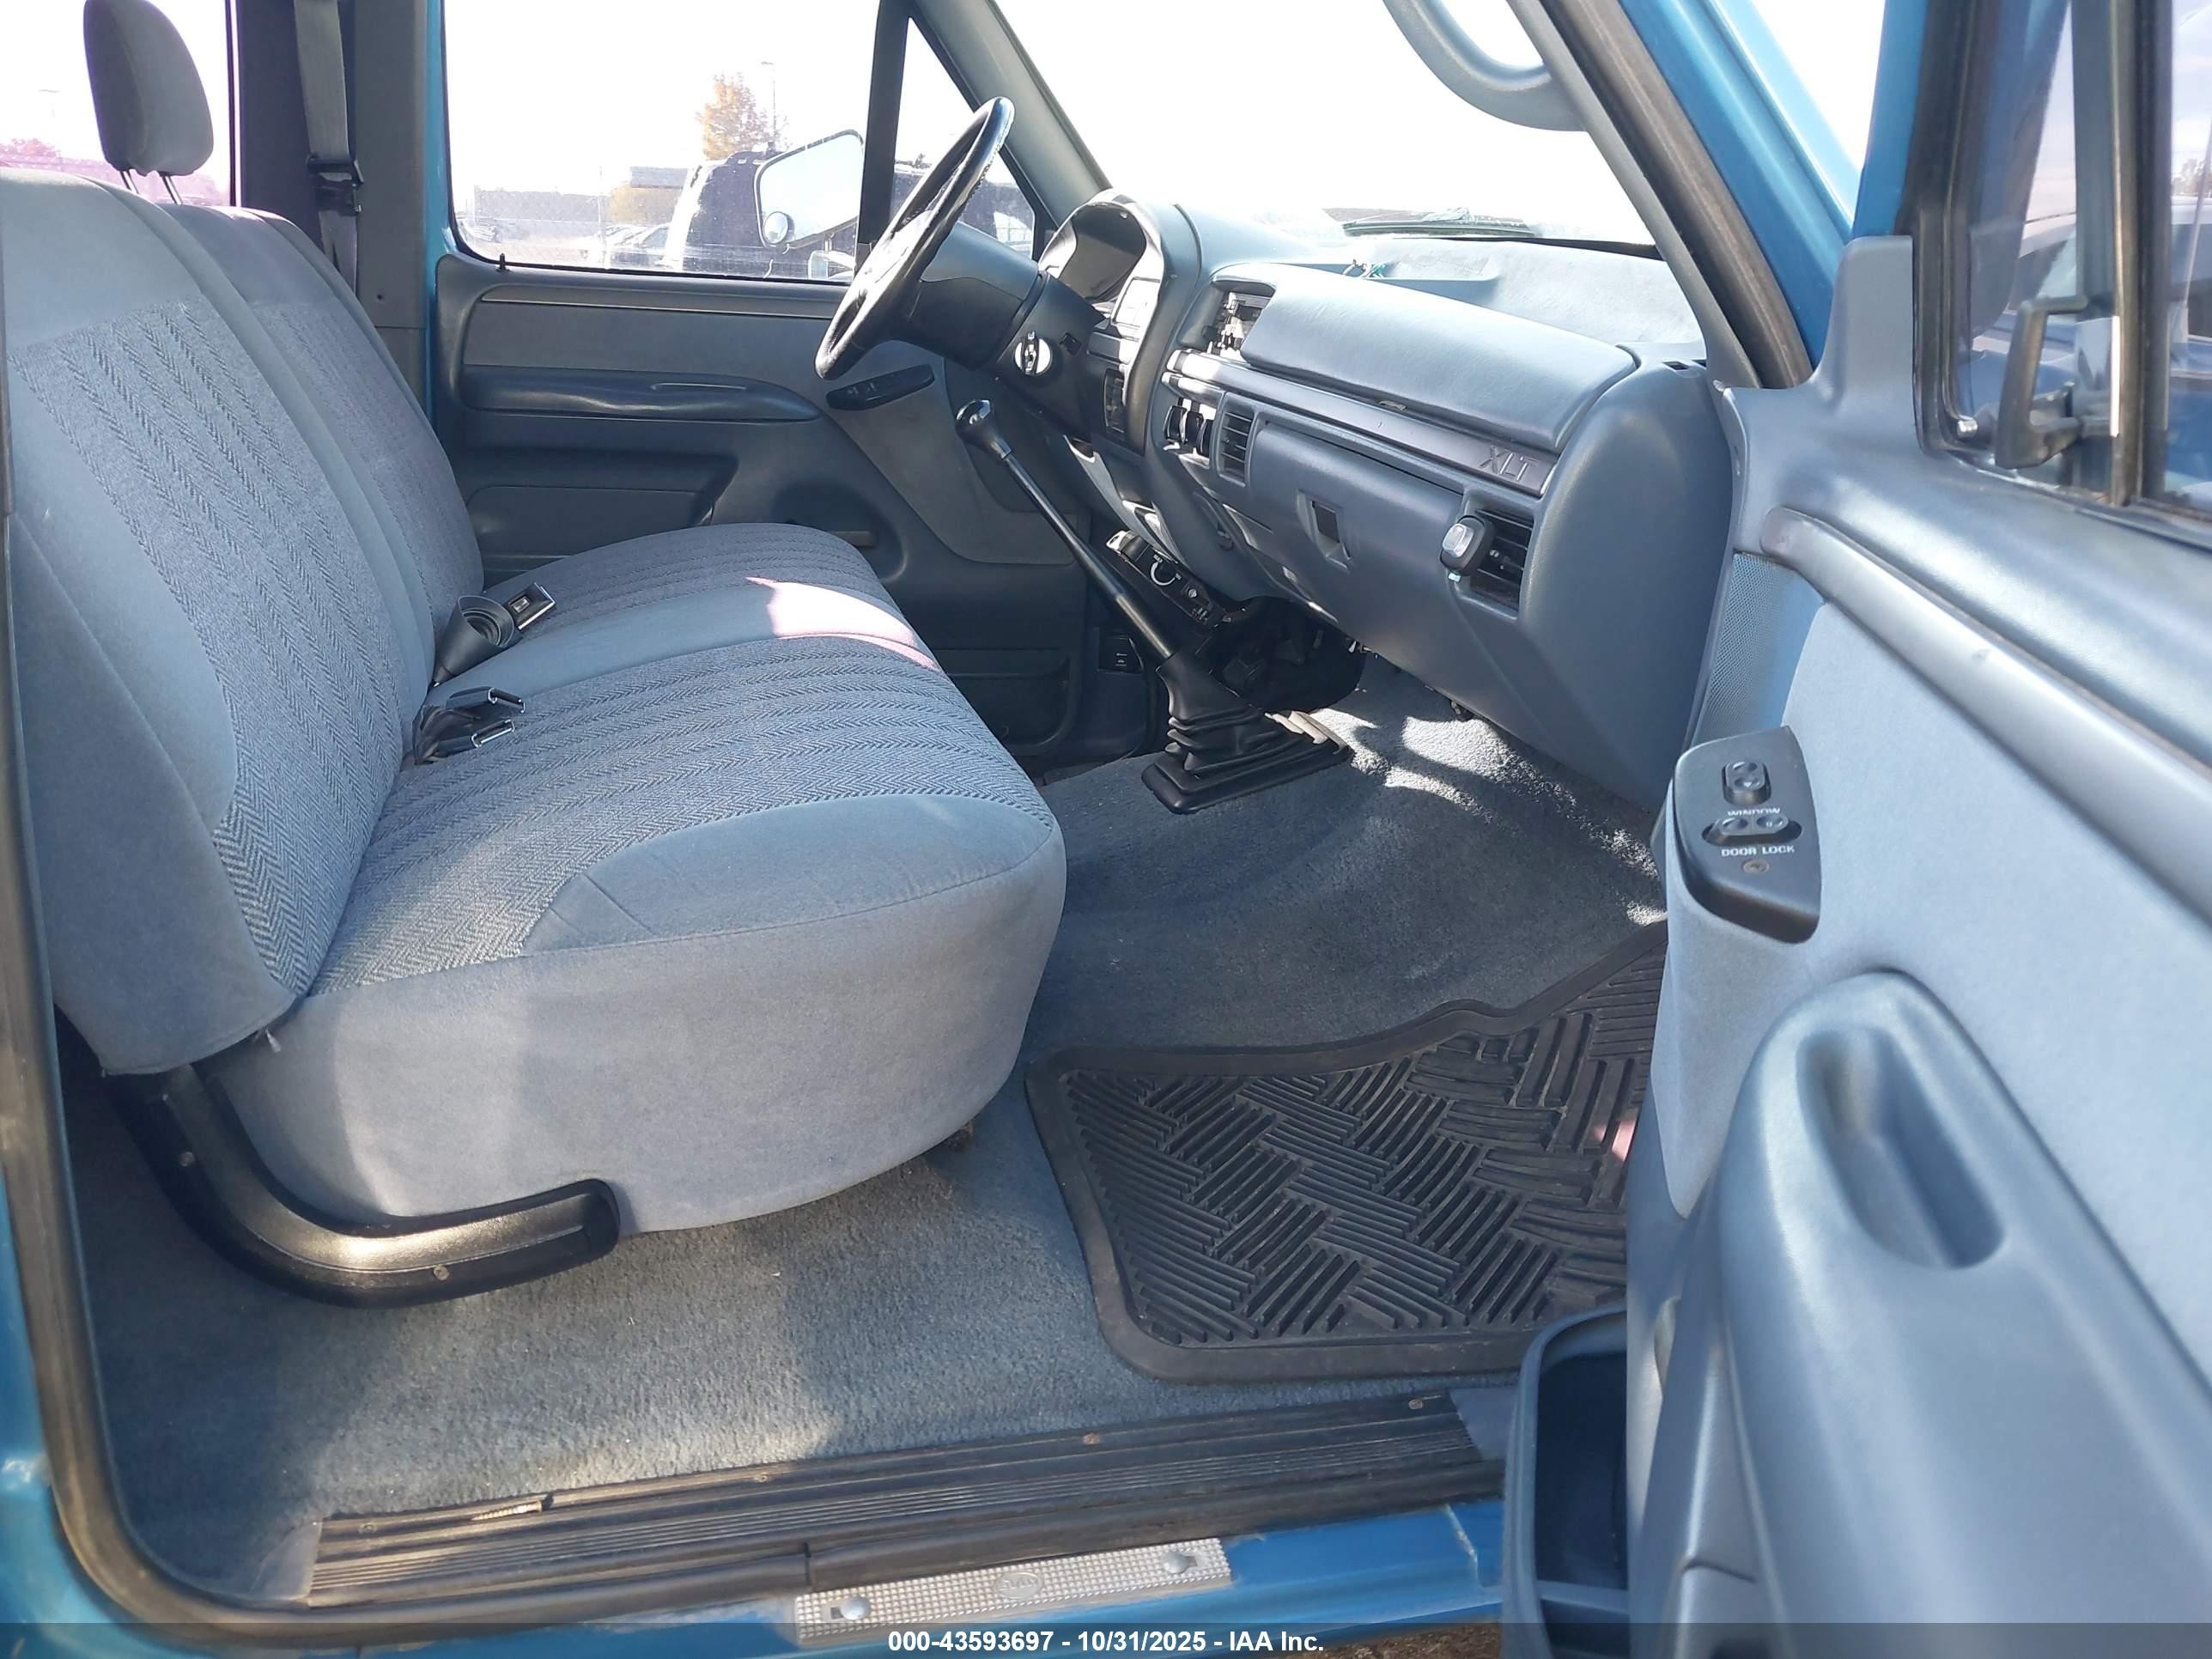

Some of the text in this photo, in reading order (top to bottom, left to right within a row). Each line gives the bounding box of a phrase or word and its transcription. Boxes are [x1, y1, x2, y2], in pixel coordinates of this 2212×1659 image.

[1479, 445, 1540, 482] XLT
[1721, 845, 1795, 857] DOOR LOCK
